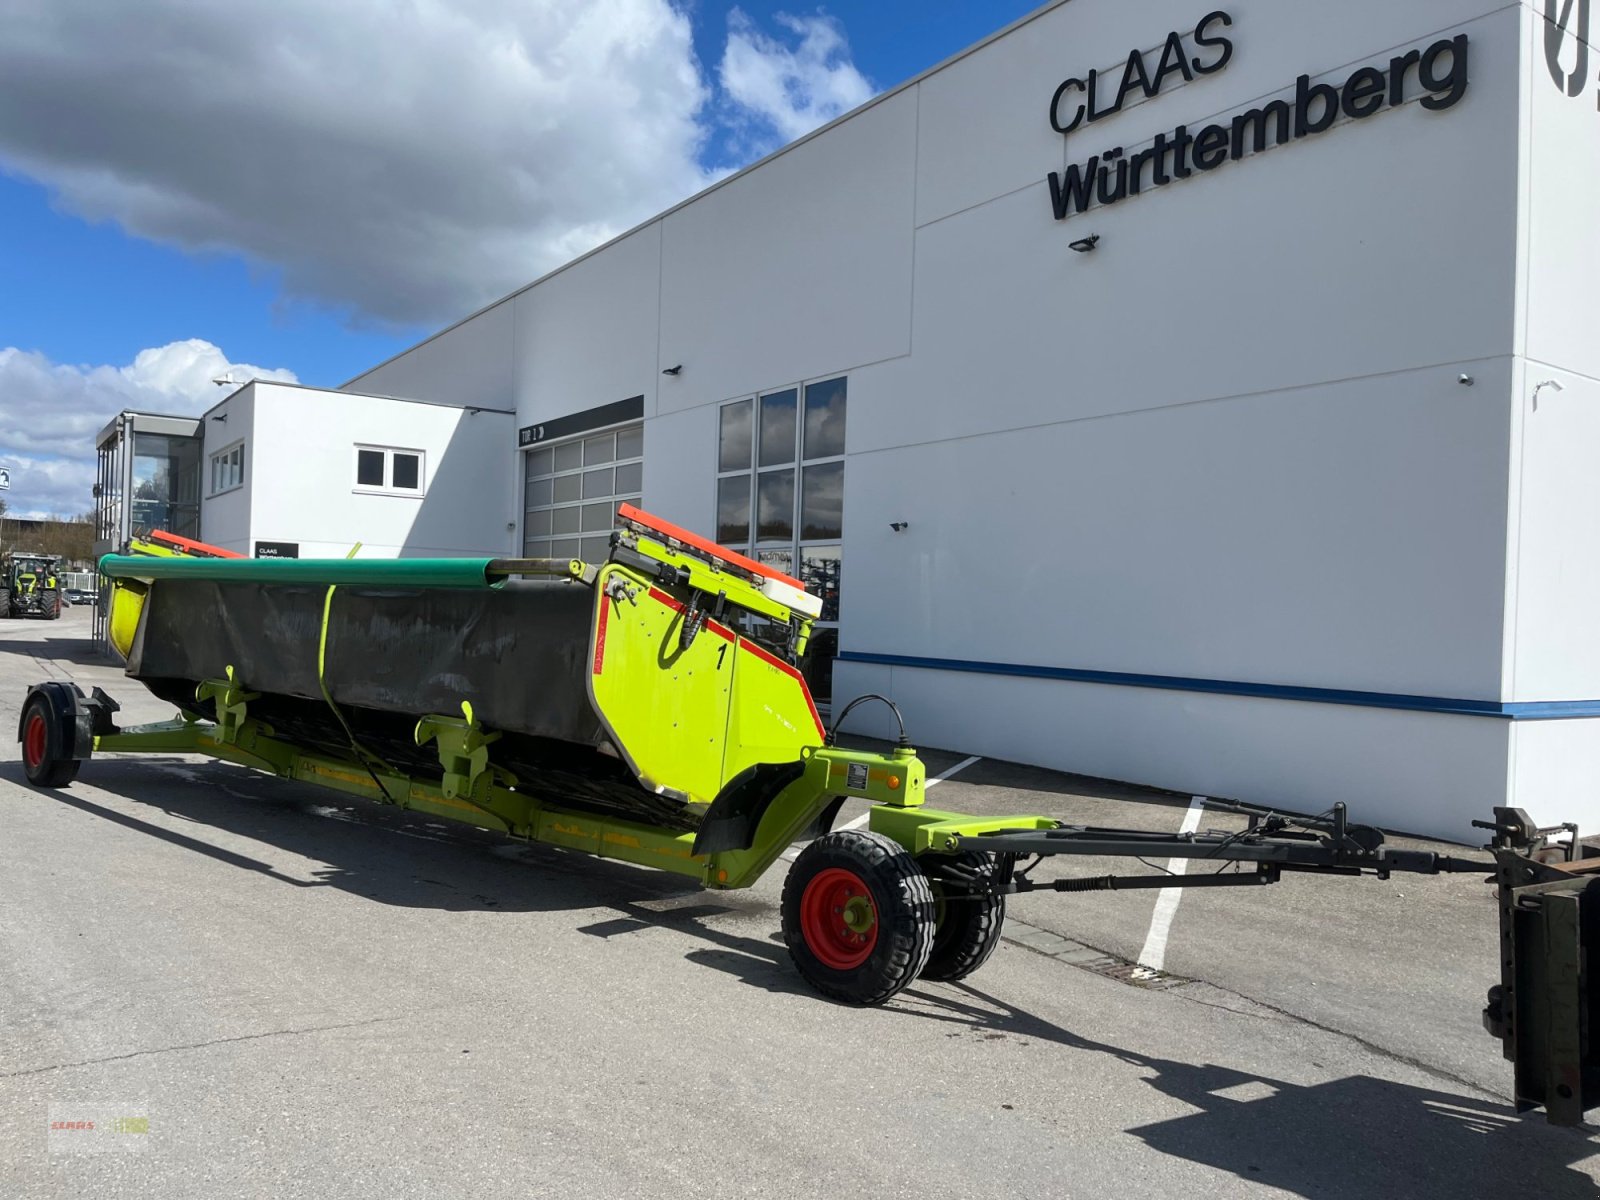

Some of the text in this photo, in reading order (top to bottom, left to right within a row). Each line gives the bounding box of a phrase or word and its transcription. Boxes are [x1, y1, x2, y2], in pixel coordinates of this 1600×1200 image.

[1048, 33, 1470, 220] Württemberg
[1050, 11, 1234, 134] CLAAS
[717, 643, 728, 671] 1
